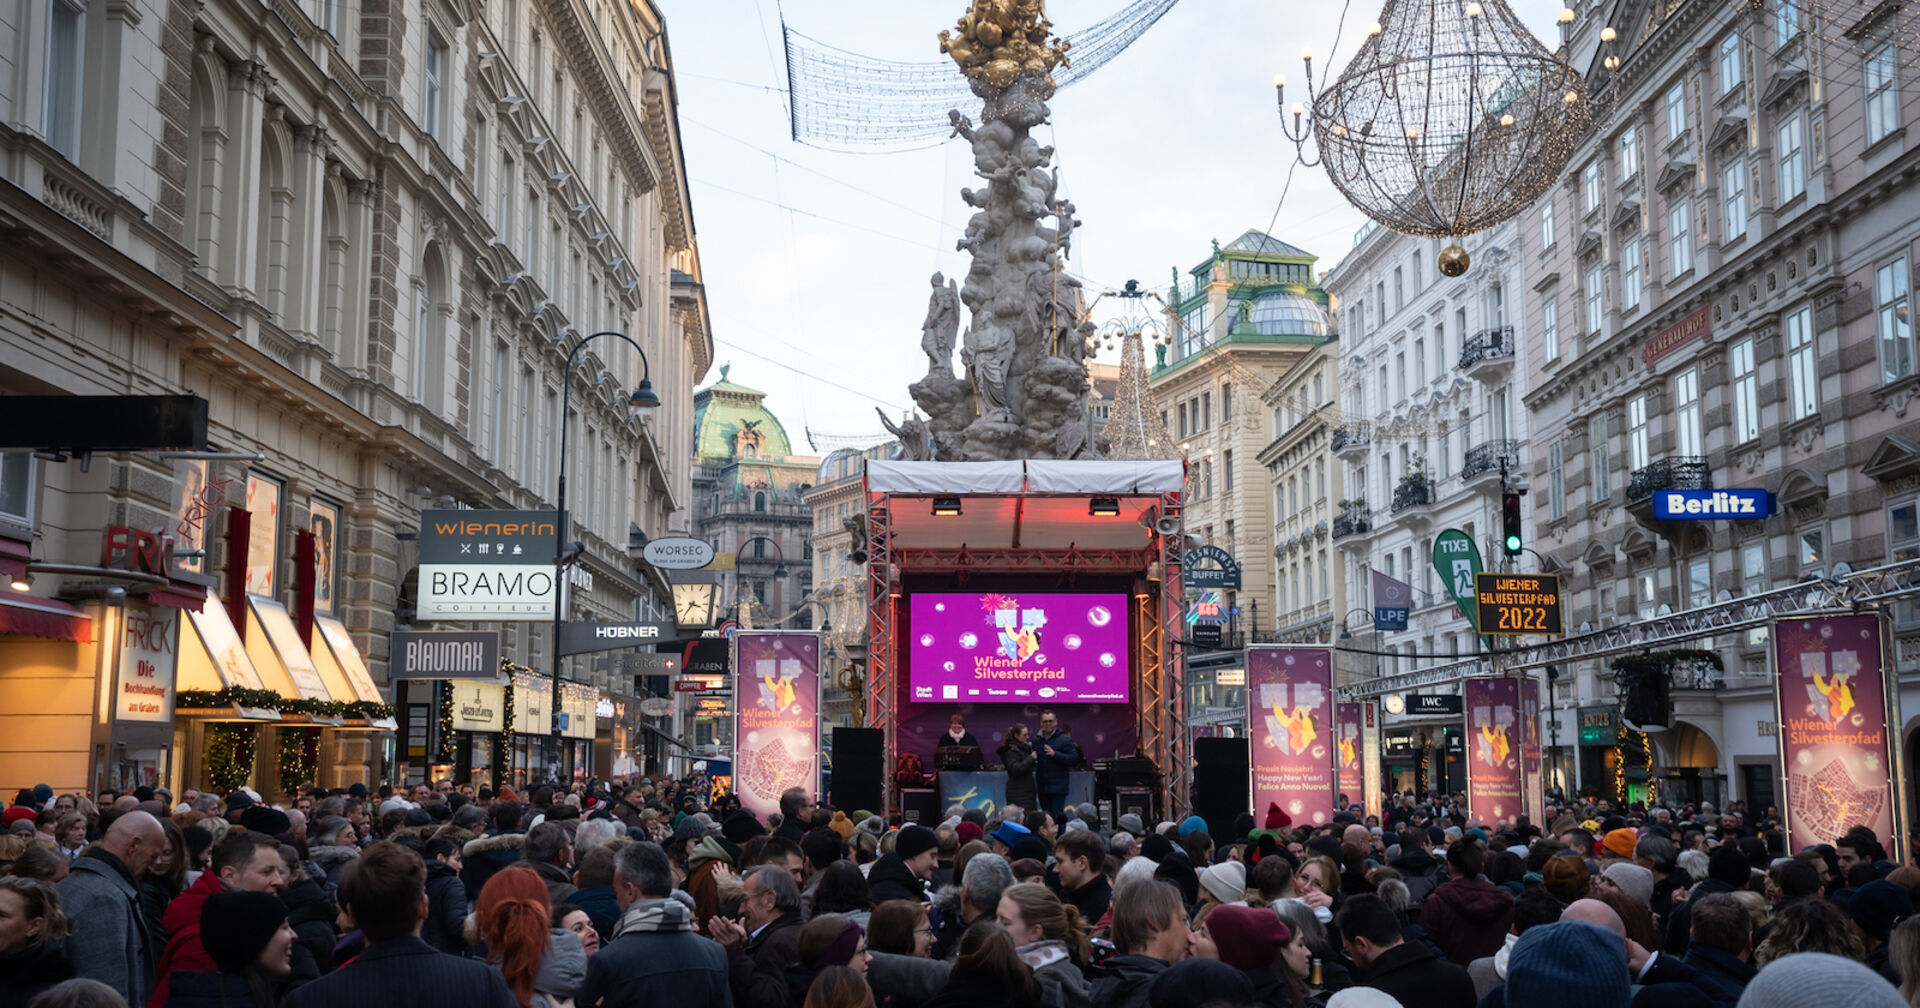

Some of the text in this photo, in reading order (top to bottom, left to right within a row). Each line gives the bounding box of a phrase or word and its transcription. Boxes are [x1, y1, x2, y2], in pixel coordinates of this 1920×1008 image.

[176, 469, 234, 541] FRICK
[1667, 492, 1756, 514] Berlitz
[435, 520, 554, 536] wienerin
[654, 545, 703, 556] WORSEG
[1192, 570, 1225, 580] BUFFET
[432, 572, 552, 596] BRAMO
[1496, 579, 1540, 591] WIENER
[1480, 592, 1556, 605] SILVESTERPFAD
[1380, 610, 1405, 621] LPE
[1498, 607, 1547, 629] 2022
[126, 616, 172, 654] FRICK
[596, 626, 659, 638] HÜBNER
[974, 656, 1024, 668] Wiener
[138, 660, 155, 677] Die
[974, 667, 1065, 682] Silvesterpfad
[139, 701, 160, 713] Graben
[1422, 697, 1442, 707] IWC
[743, 707, 781, 718] Wiener
[743, 717, 813, 729] Silvesterpfad
[1789, 717, 1839, 732] Wiener
[1790, 731, 1881, 747] Silvesterpfad
[1257, 764, 1313, 774] Prosit Neujahr!
[1257, 773, 1323, 783] Happy New Year!
[1258, 782, 1279, 790] Felice
